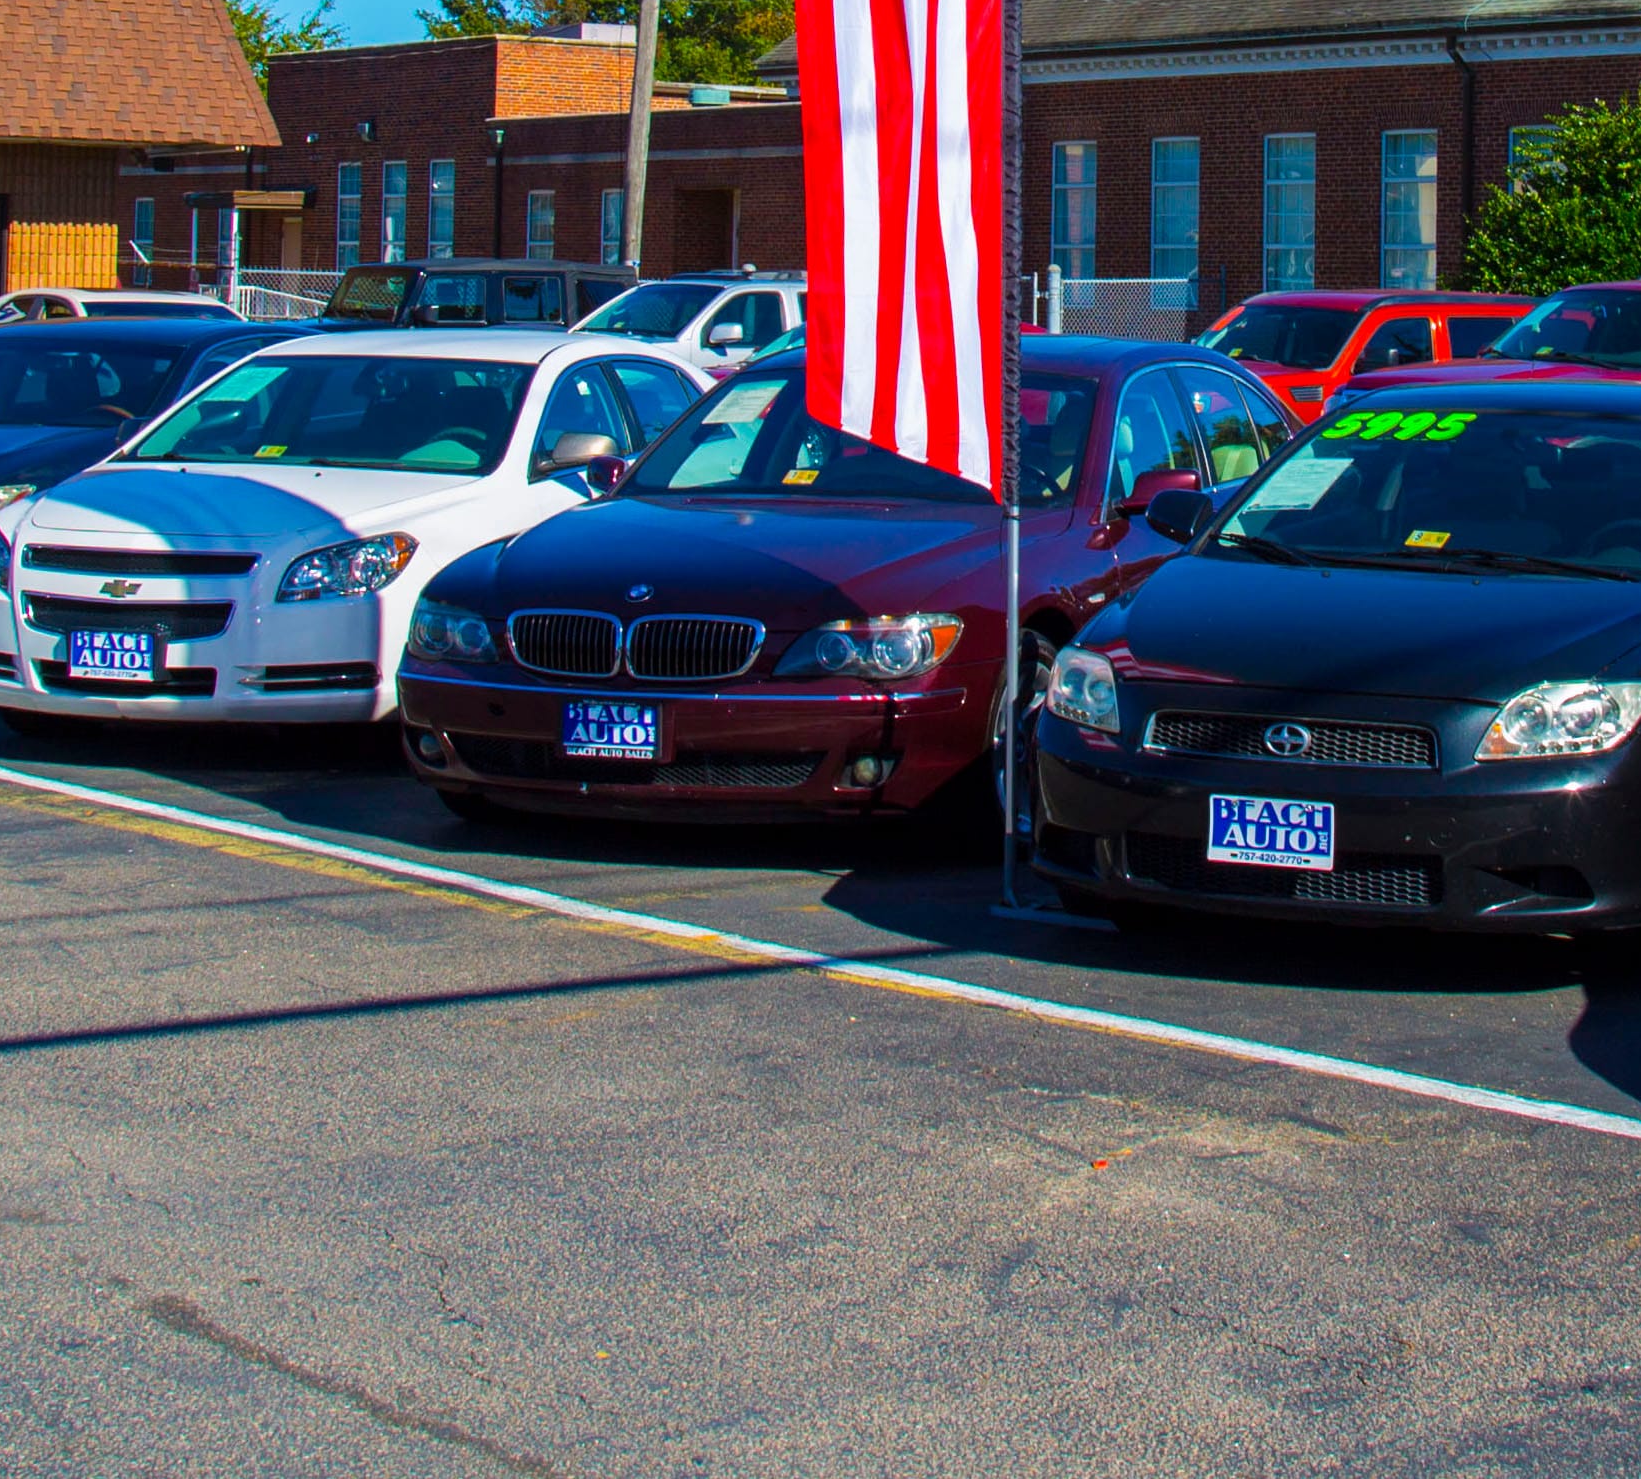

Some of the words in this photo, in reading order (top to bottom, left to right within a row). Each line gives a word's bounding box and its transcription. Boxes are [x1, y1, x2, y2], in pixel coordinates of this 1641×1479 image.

[1322, 411, 1477, 440] 5995
[78, 648, 143, 669] AUTO
[570, 722, 647, 745] AUTO
[566, 746, 597, 756] BEACH
[598, 748, 623, 758] AUTO
[624, 750, 653, 759] SALES
[1215, 798, 1331, 827] BEACH
[1222, 823, 1317, 852] AUTO
